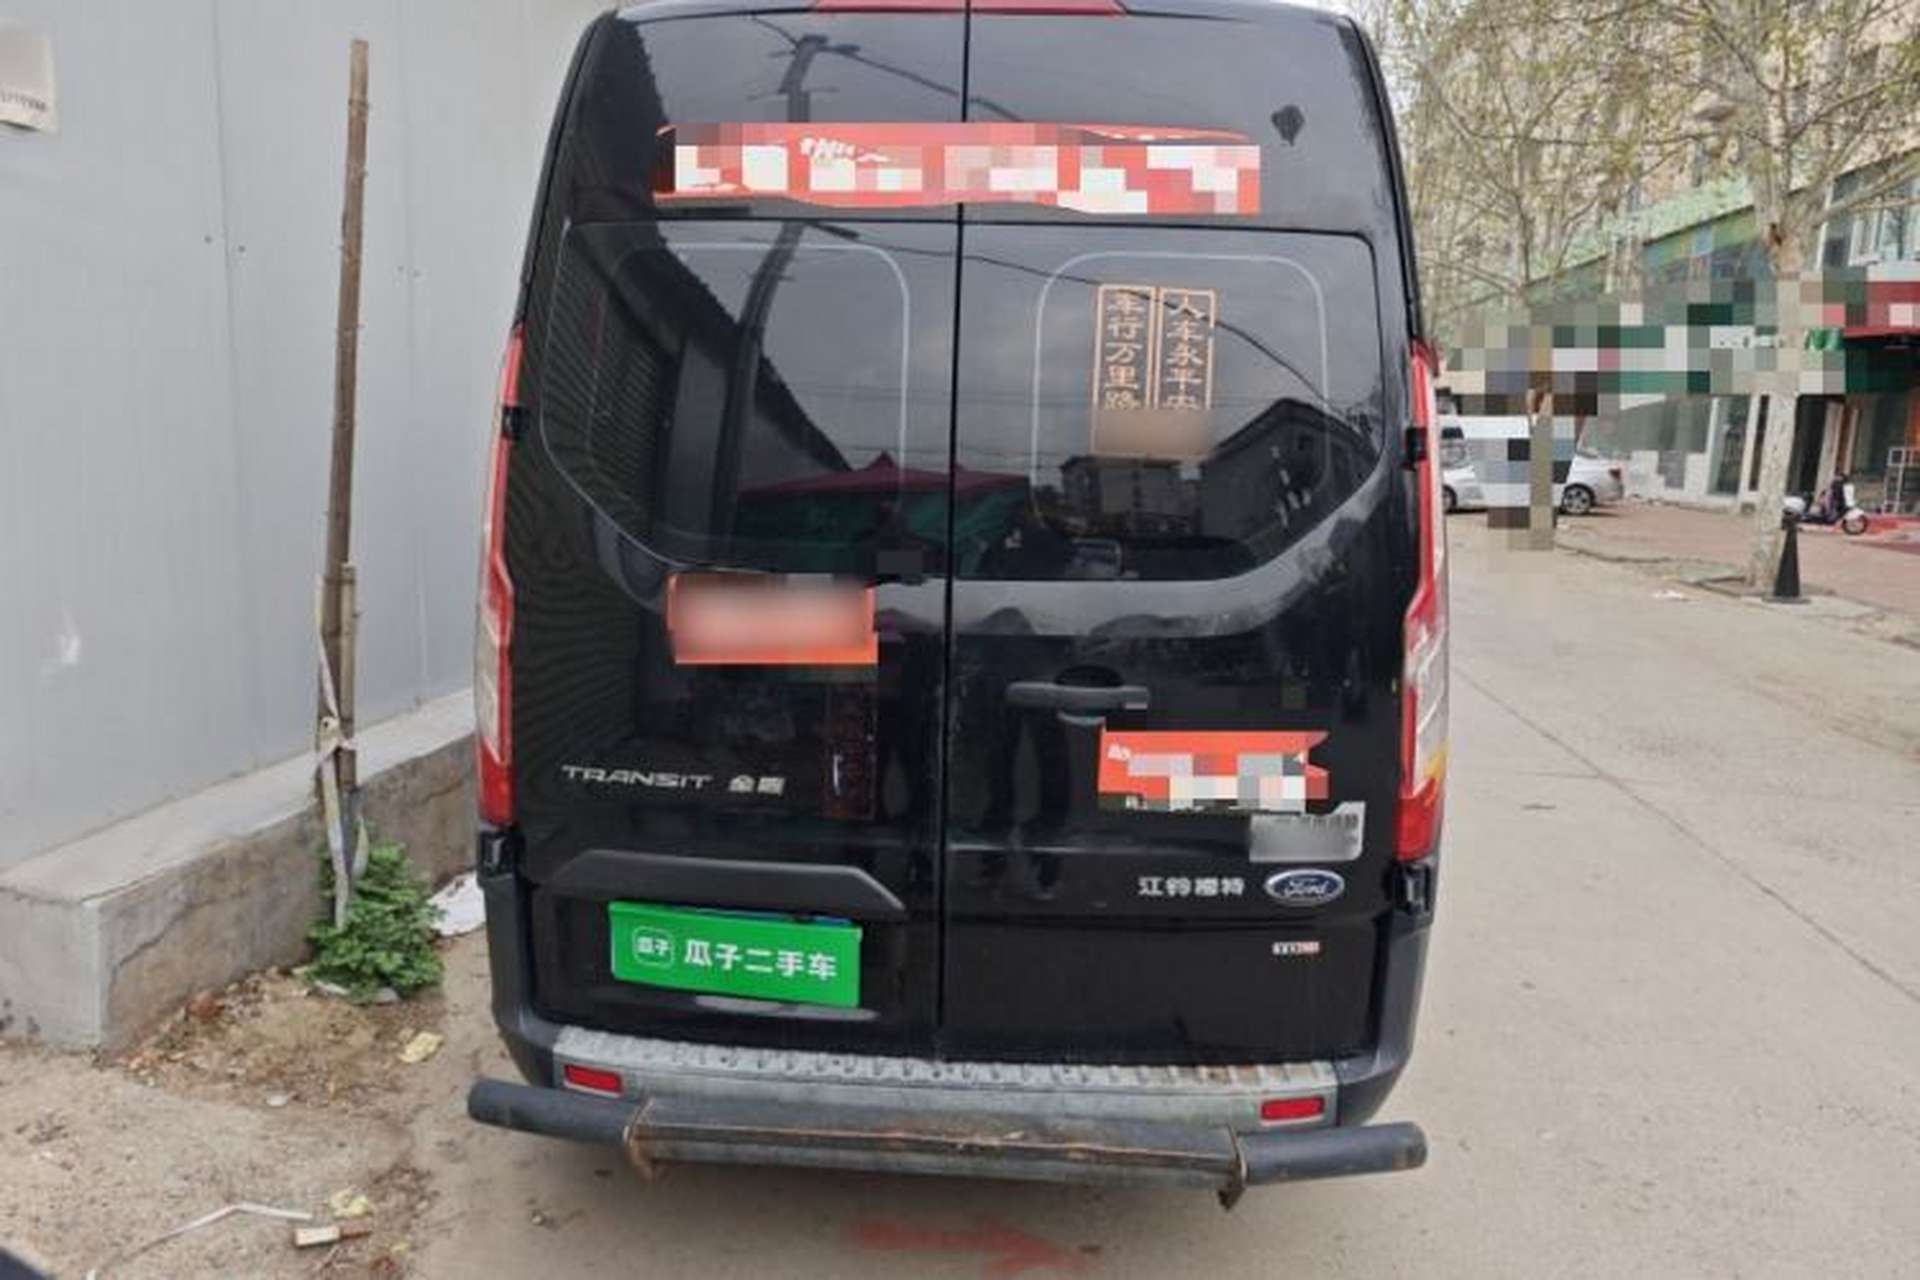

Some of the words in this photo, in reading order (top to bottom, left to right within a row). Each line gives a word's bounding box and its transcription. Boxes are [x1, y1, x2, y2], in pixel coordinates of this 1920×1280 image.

[561, 764, 713, 789] TRANSIT
[684, 937, 837, 981] 瓜子二手车
